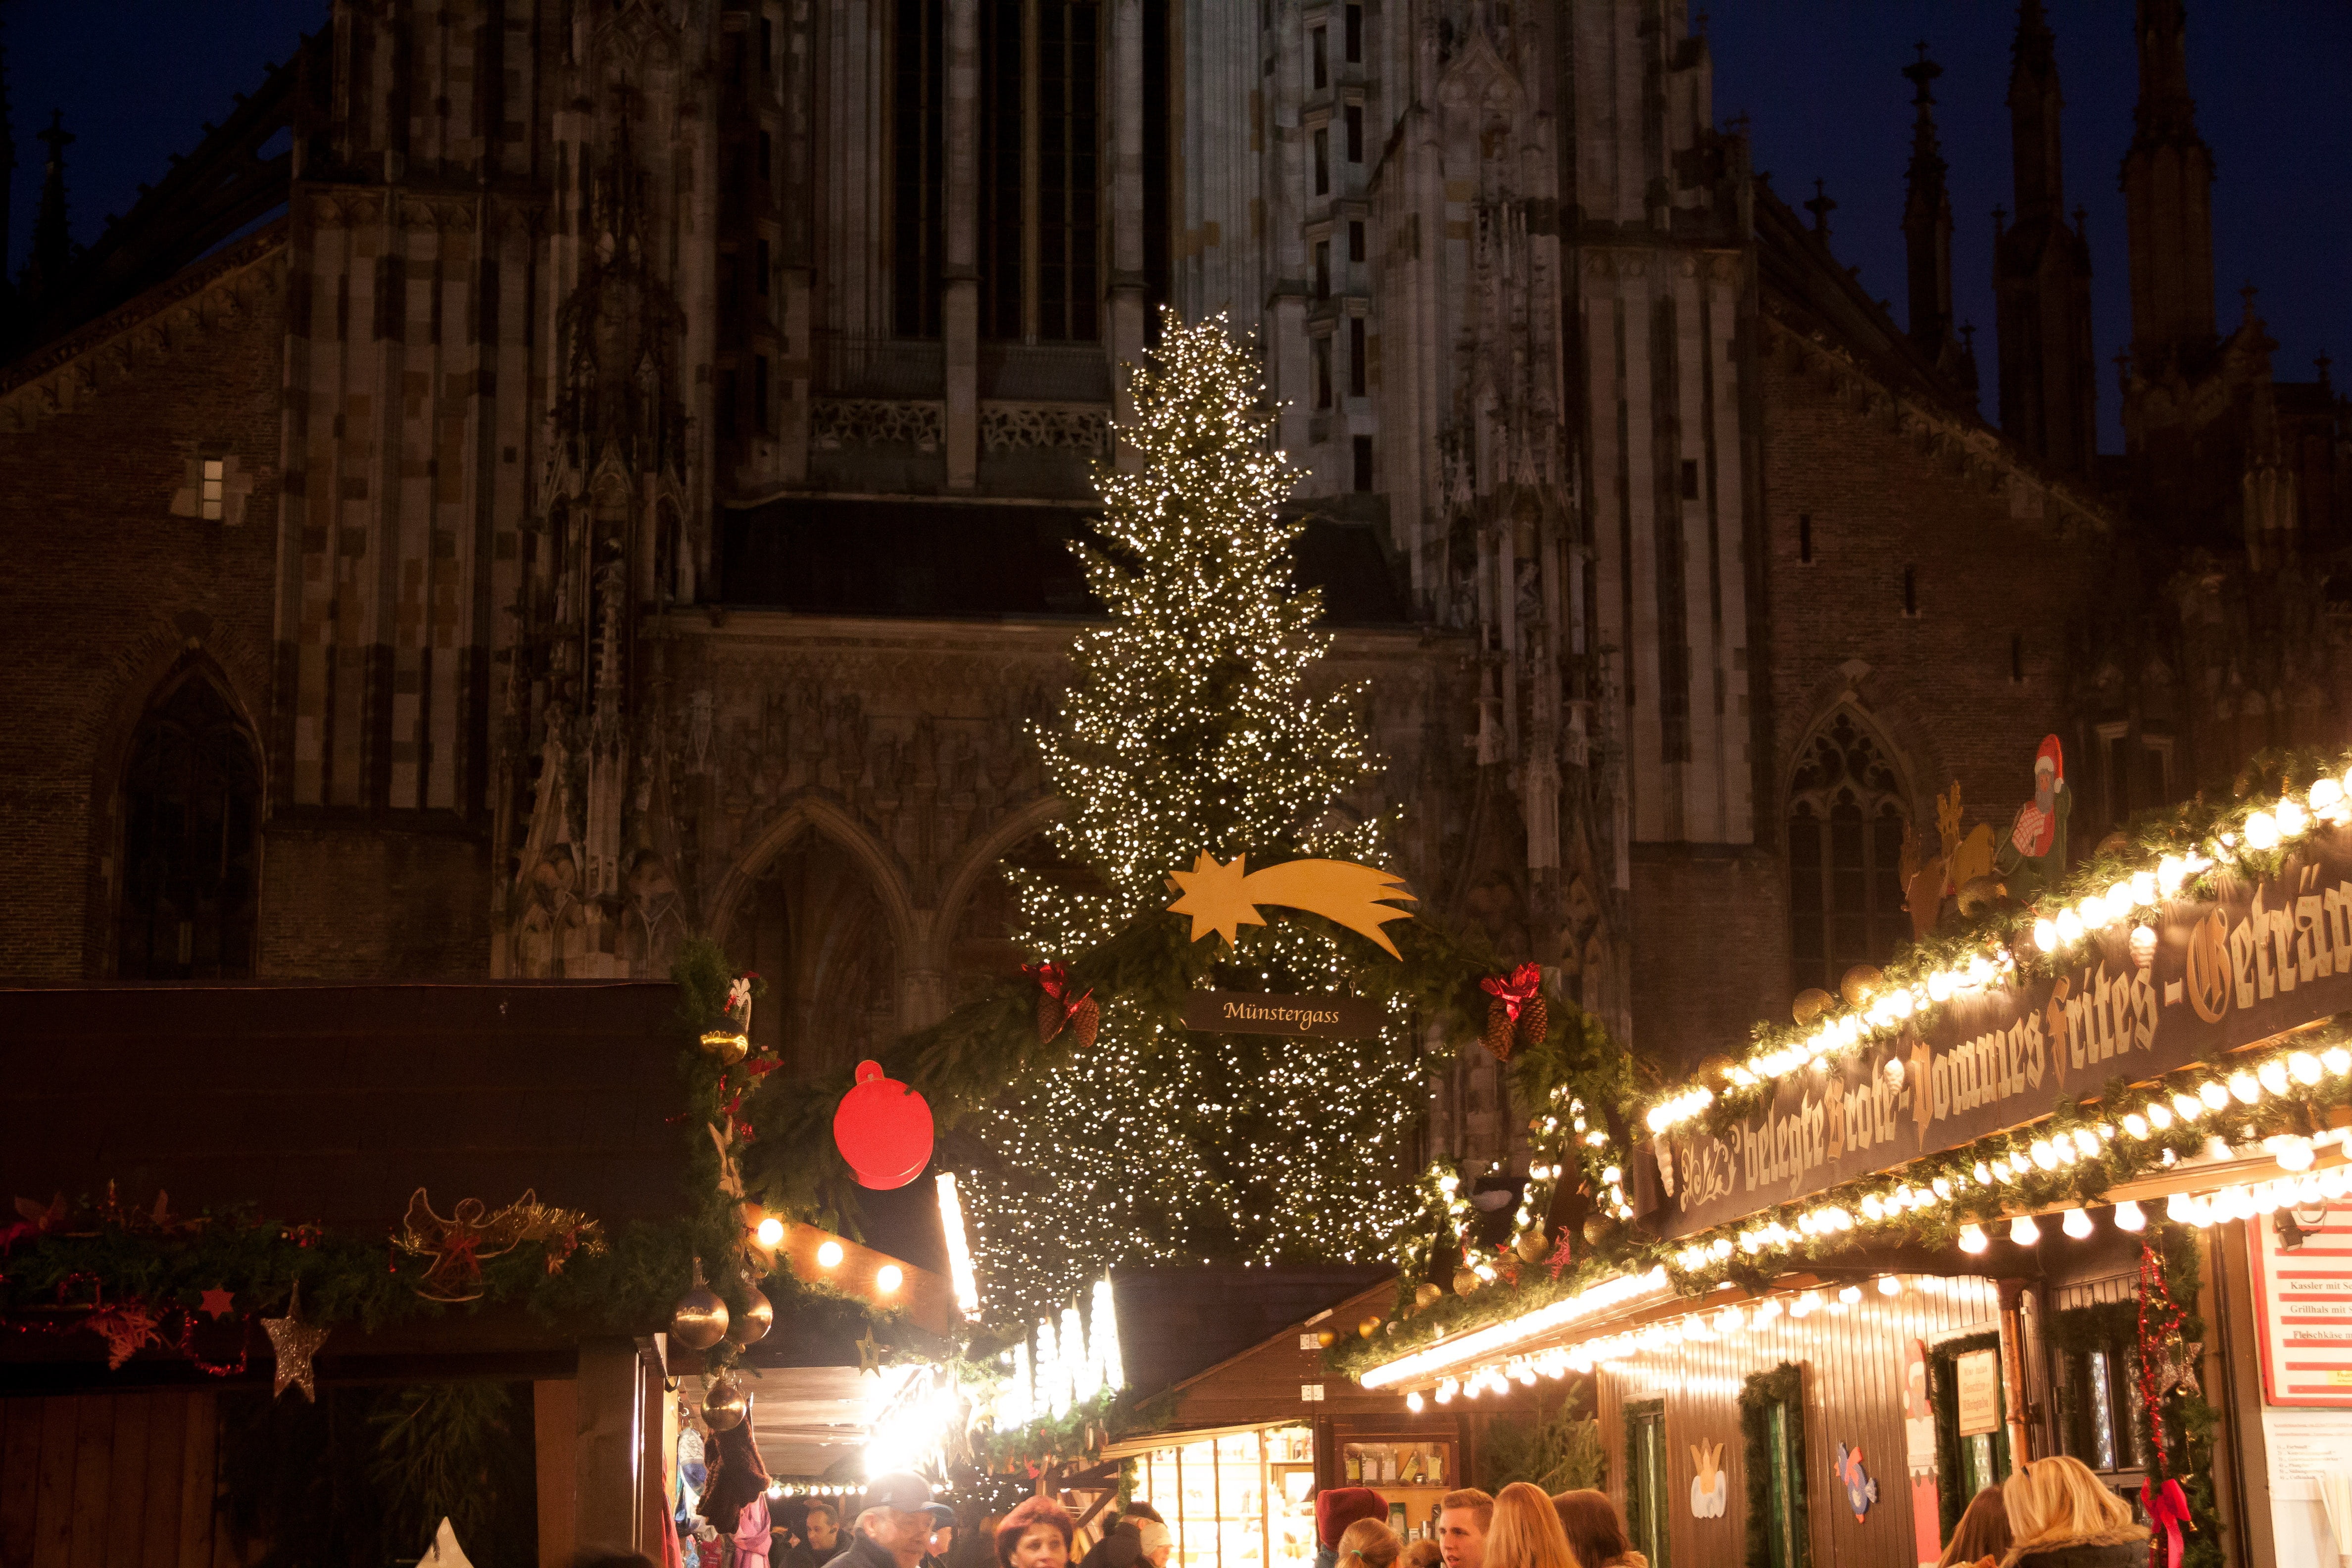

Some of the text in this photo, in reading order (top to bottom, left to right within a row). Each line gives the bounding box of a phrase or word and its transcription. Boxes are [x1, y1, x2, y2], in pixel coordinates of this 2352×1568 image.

[1224, 1002, 1339, 1030] Münstergass
[1743, 1088, 1824, 1198] belegte
[1911, 1008, 2045, 1152] Pommes
[2046, 959, 2158, 1087] Frites
[2293, 1330, 2343, 1339] Fleischkäse
